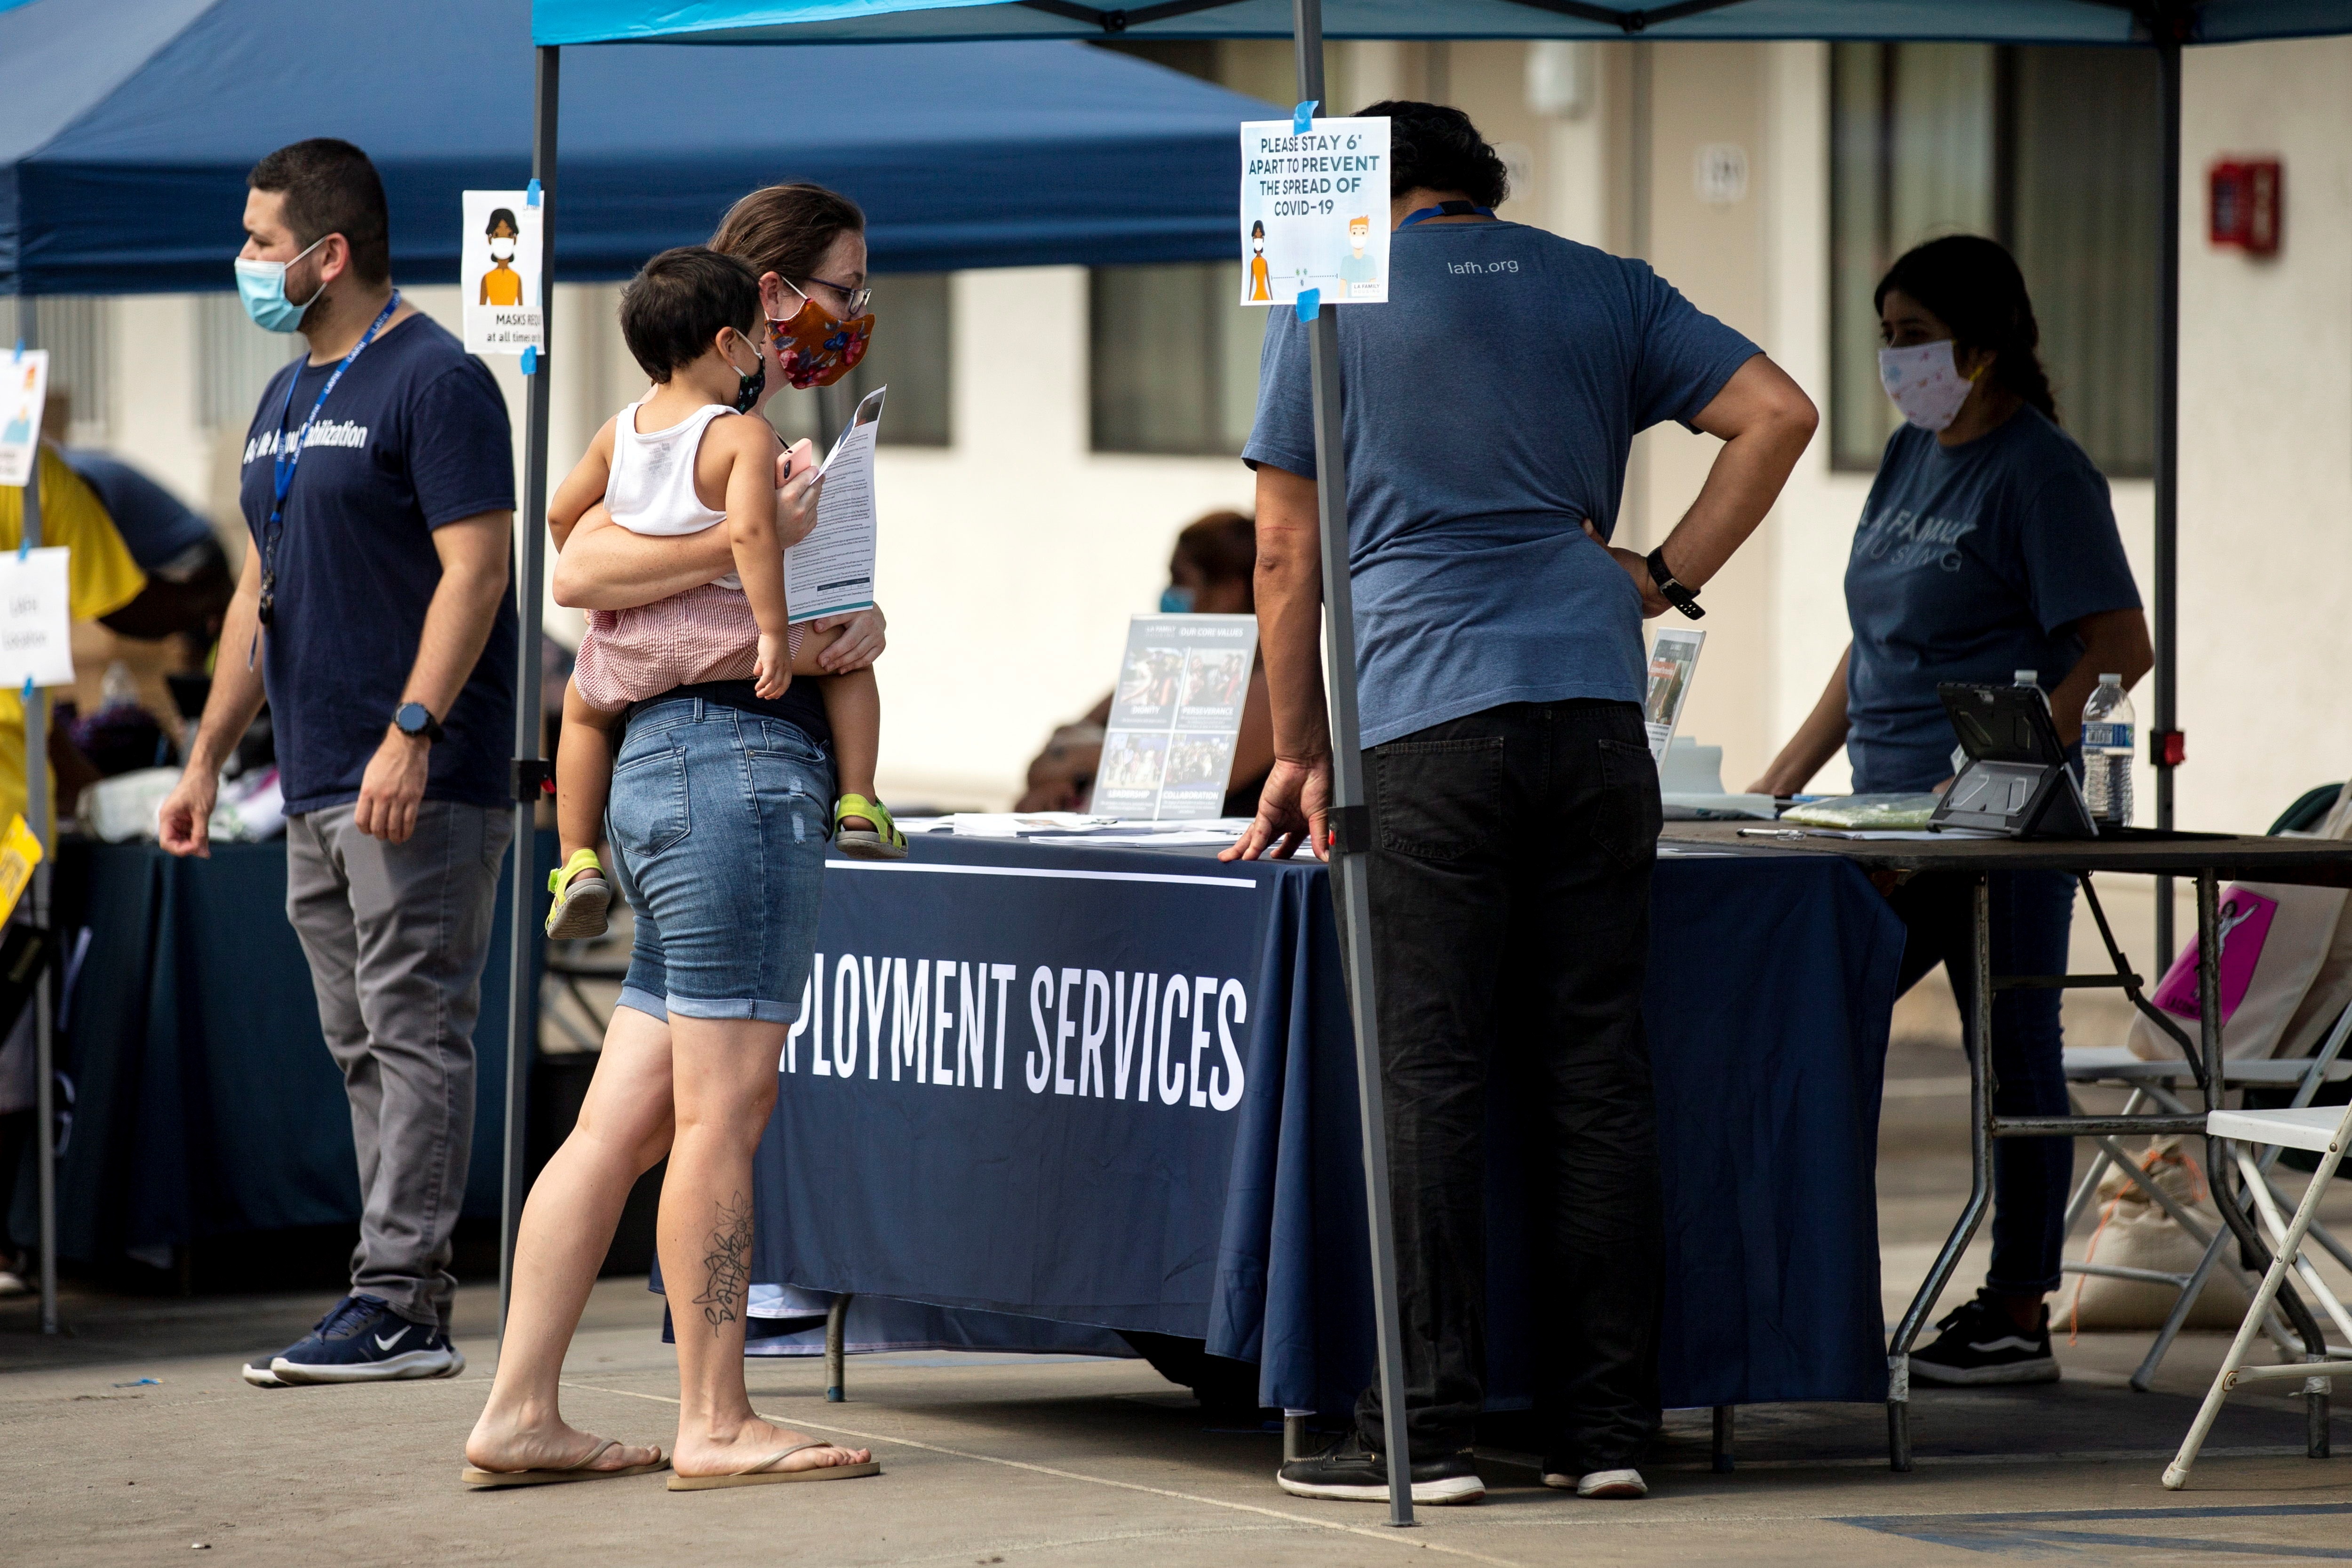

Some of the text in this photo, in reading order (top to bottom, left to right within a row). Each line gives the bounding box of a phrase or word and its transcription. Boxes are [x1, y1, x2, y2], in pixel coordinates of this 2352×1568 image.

[1261, 134, 1362, 153] PLEASE STAY 6'
[1249, 155, 1380, 175] APART TO PREVENT
[1260, 177, 1361, 196] THE SPREAD OF
[1274, 199, 1334, 216] COVID-19
[1447, 260, 1519, 274] lafh.org
[496, 314, 525, 325] MASKS
[487, 332, 495, 342] at
[499, 330, 510, 342] all
[513, 331, 530, 342] times
[1180, 627, 1197, 637] OUR
[1198, 628, 1216, 637] CORE
[1217, 628, 1243, 637] VALUES
[1131, 706, 1160, 715] DIGNITY
[1182, 707, 1234, 716] PERSEVERANCE
[1107, 789, 1150, 799] LEADERSHIP
[1163, 790, 1219, 800] COLLABORATION
[1025, 965, 1247, 1111] SERVICES
